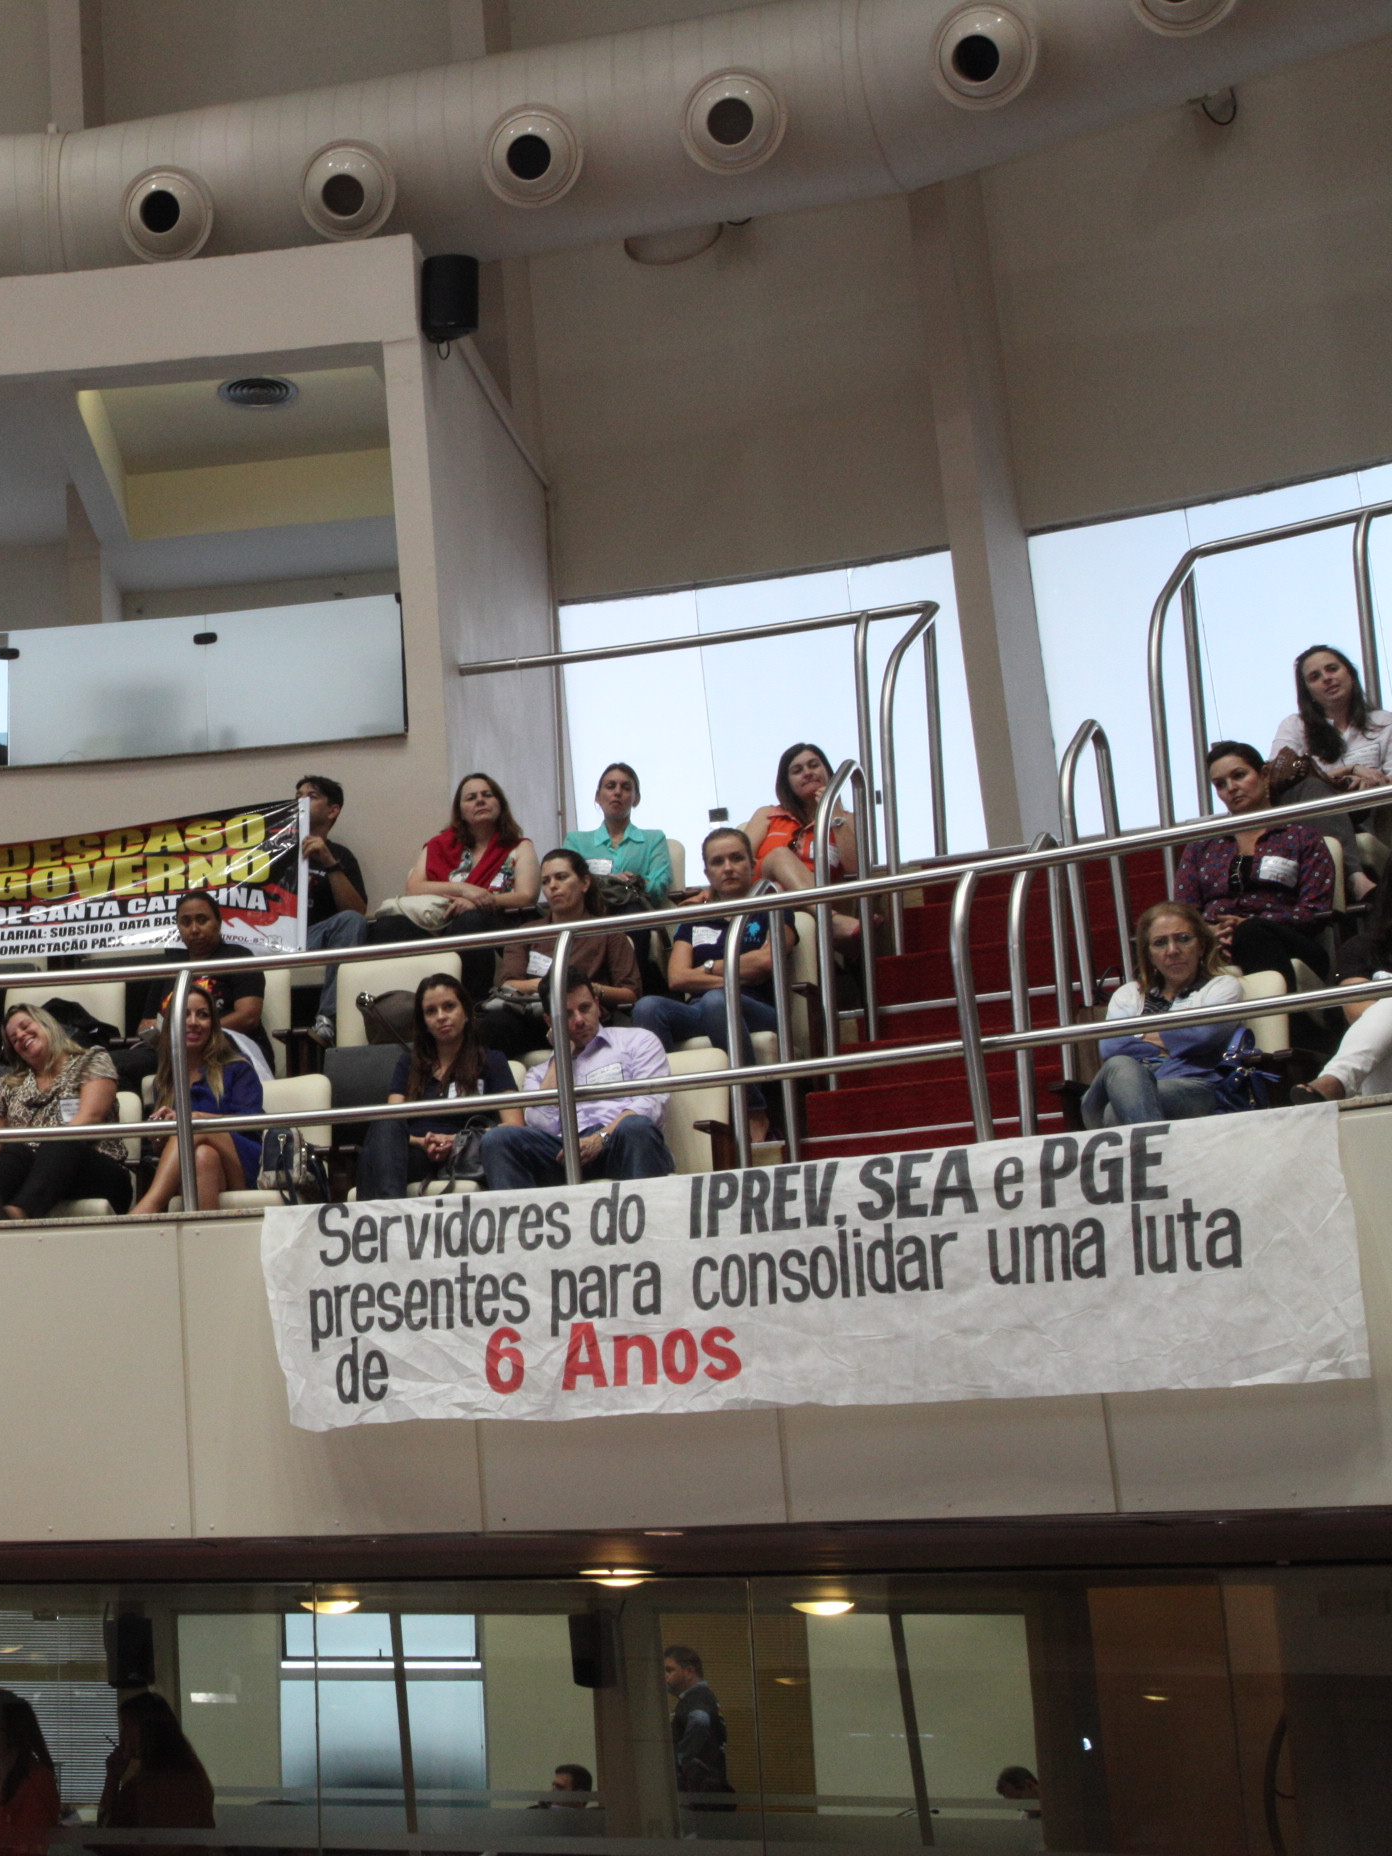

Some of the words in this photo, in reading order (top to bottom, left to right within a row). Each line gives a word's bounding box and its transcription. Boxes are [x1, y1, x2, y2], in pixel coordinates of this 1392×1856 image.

[29, 898, 122, 923] SANTA
[127, 886, 268, 915] CATINA
[119, 919, 151, 931] DATA
[154, 914, 178, 927] BAS
[317, 1194, 572, 1268] Servidores
[590, 1182, 646, 1246] do
[857, 1148, 980, 1222] SEA
[993, 1155, 1024, 1210] e
[1039, 1123, 1171, 1209] PGE
[310, 1262, 531, 1353] presentes
[550, 1260, 663, 1338] para
[692, 1222, 958, 1312] consolidar
[987, 1216, 1106, 1286] uma
[1131, 1197, 1244, 1277] luta
[336, 1336, 389, 1405] de
[484, 1326, 525, 1395] 6
[561, 1320, 743, 1392] Anos
